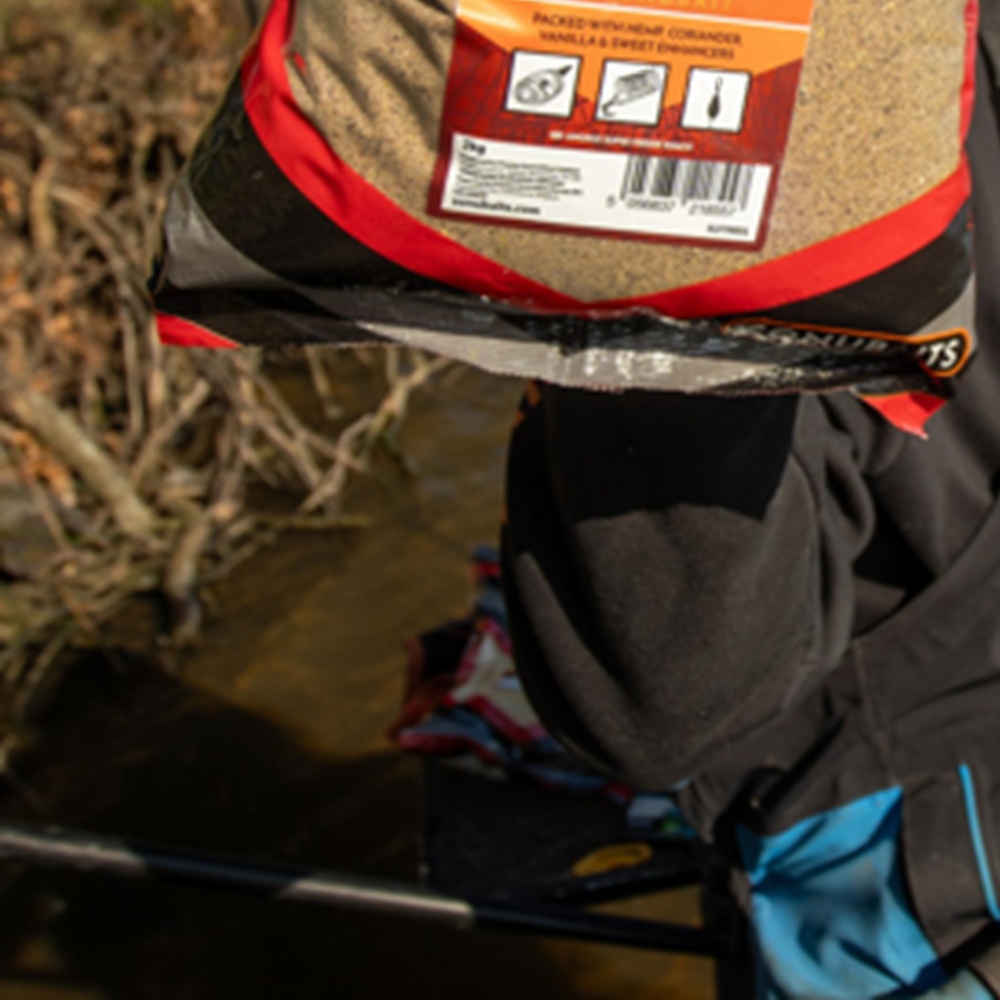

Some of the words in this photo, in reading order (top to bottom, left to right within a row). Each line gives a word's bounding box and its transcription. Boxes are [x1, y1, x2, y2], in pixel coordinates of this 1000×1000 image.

[532, 12, 585, 30] PACKED
[539, 30, 596, 47] VANILLA
[611, 36, 655, 52] SWEET
